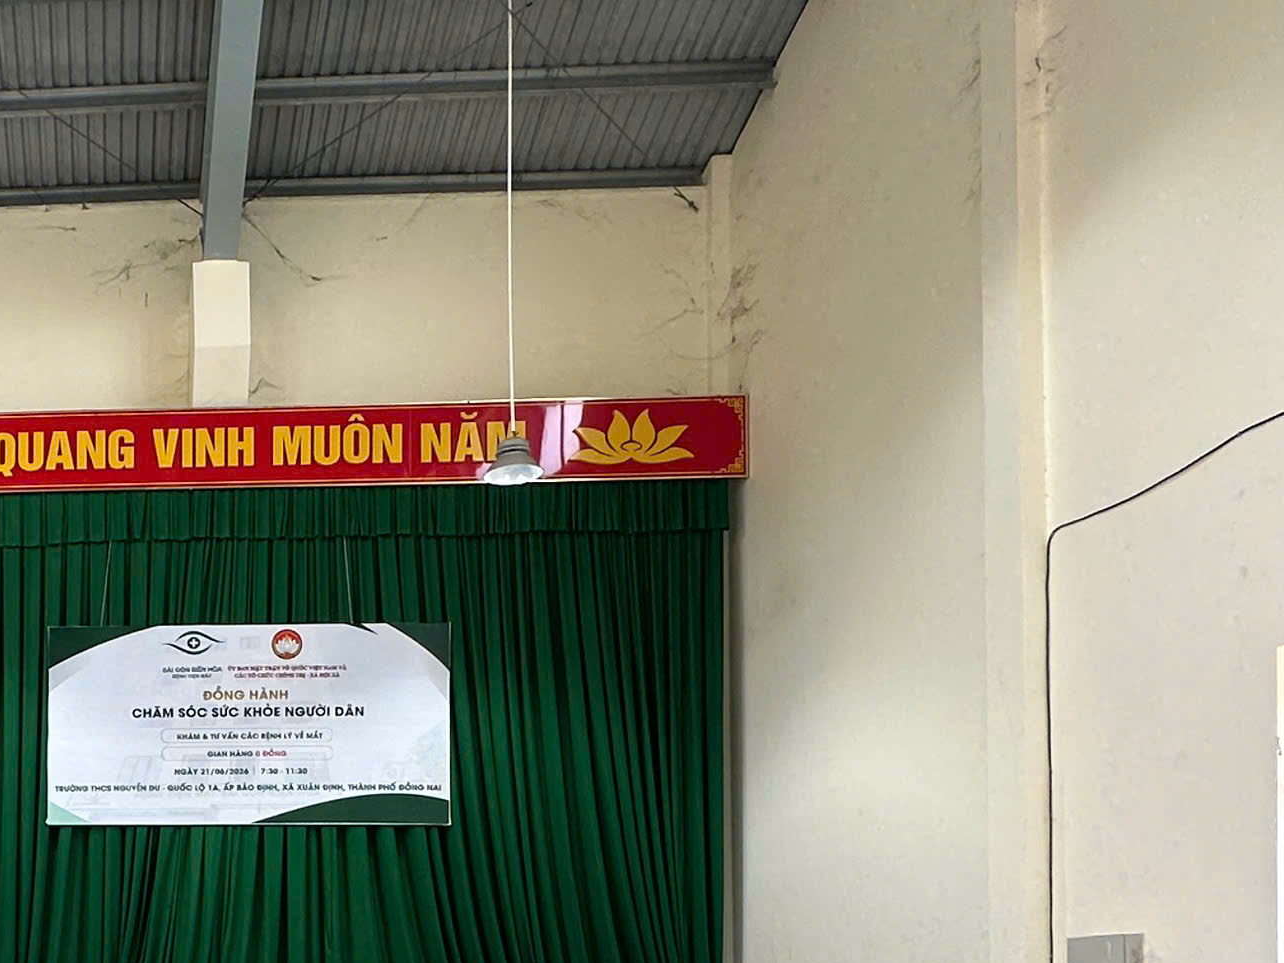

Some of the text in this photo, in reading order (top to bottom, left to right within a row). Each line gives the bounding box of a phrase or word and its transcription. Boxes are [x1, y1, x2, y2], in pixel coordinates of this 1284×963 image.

[152, 426, 255, 469] VINH
[272, 413, 403, 466] MUÔN
[420, 411, 527, 464] NĂM
[249, 687, 289, 700] HÀNH
[132, 705, 174, 718] CHĂM
[178, 704, 208, 718] SÓC
[211, 704, 239, 718] SỨC
[284, 703, 331, 717] NGƯỜI
[335, 703, 364, 717] DÂN
[91, 784, 112, 792] THCS
